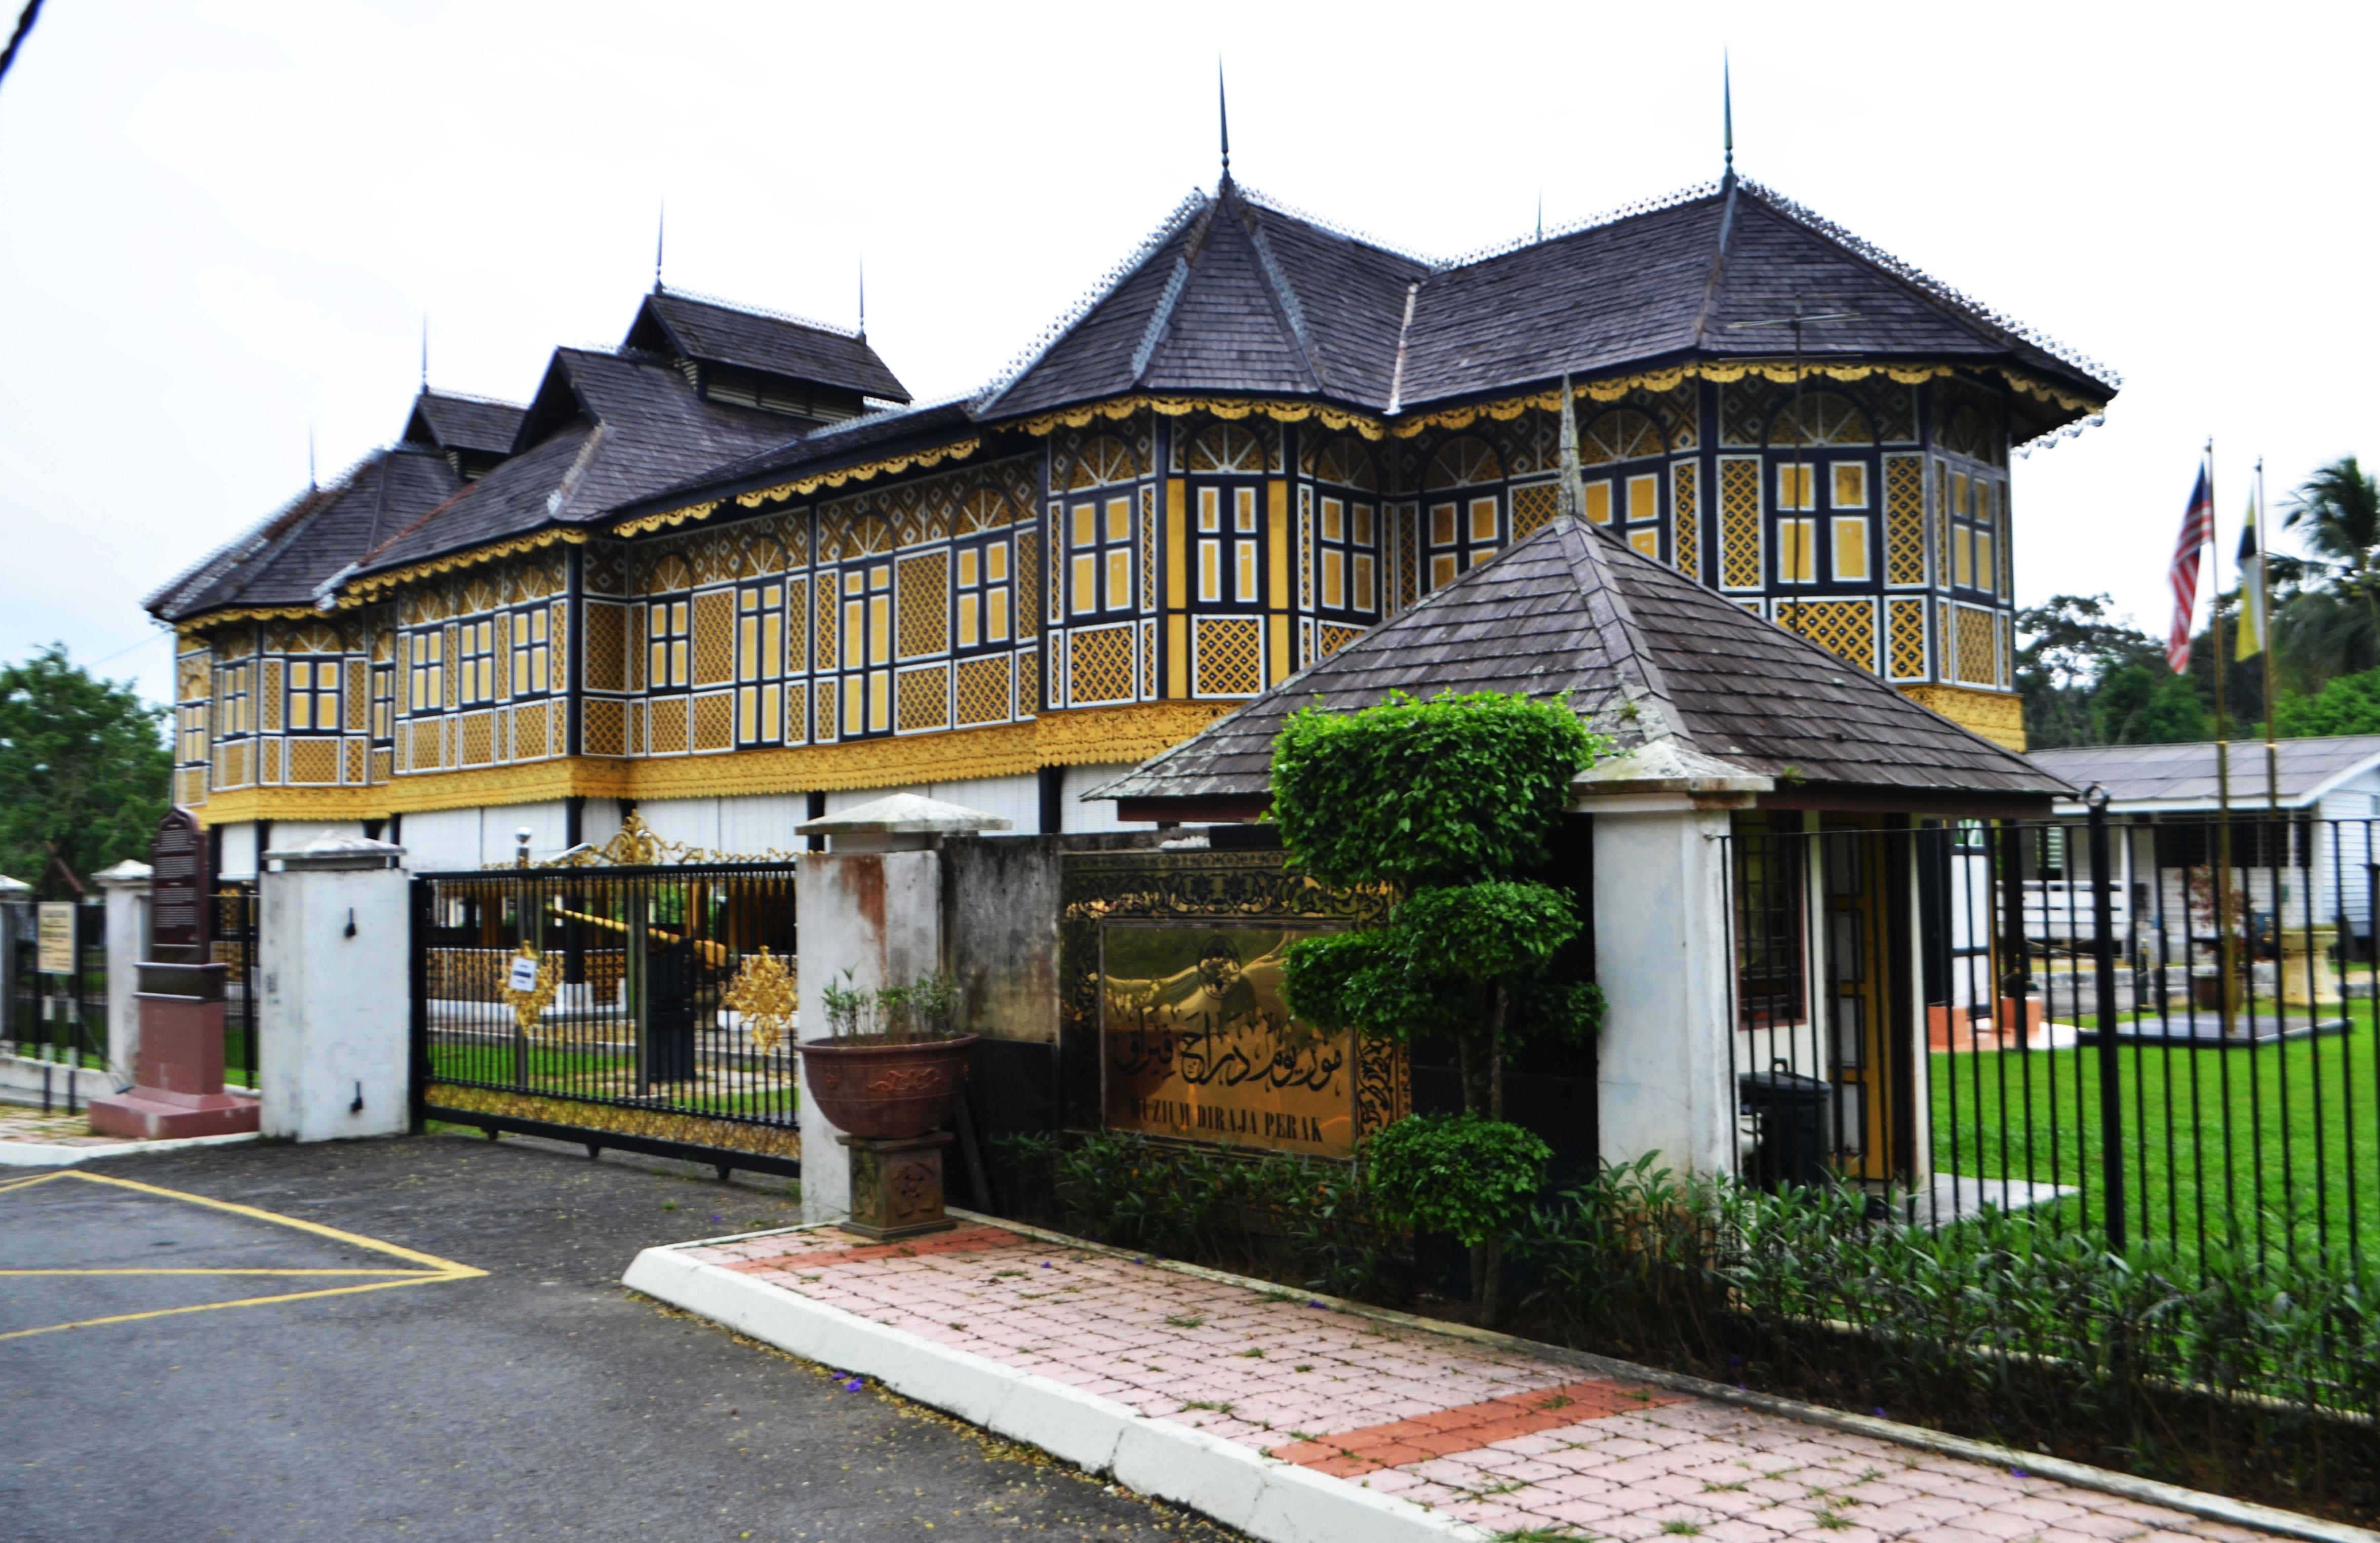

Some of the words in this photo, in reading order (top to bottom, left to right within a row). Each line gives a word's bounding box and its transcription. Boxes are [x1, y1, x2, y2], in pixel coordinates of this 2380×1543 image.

[1131, 1097, 1190, 1126] MUZIUM
[1198, 1105, 1258, 1134] DIRAJA
[1265, 1112, 1323, 1143] PERAK
